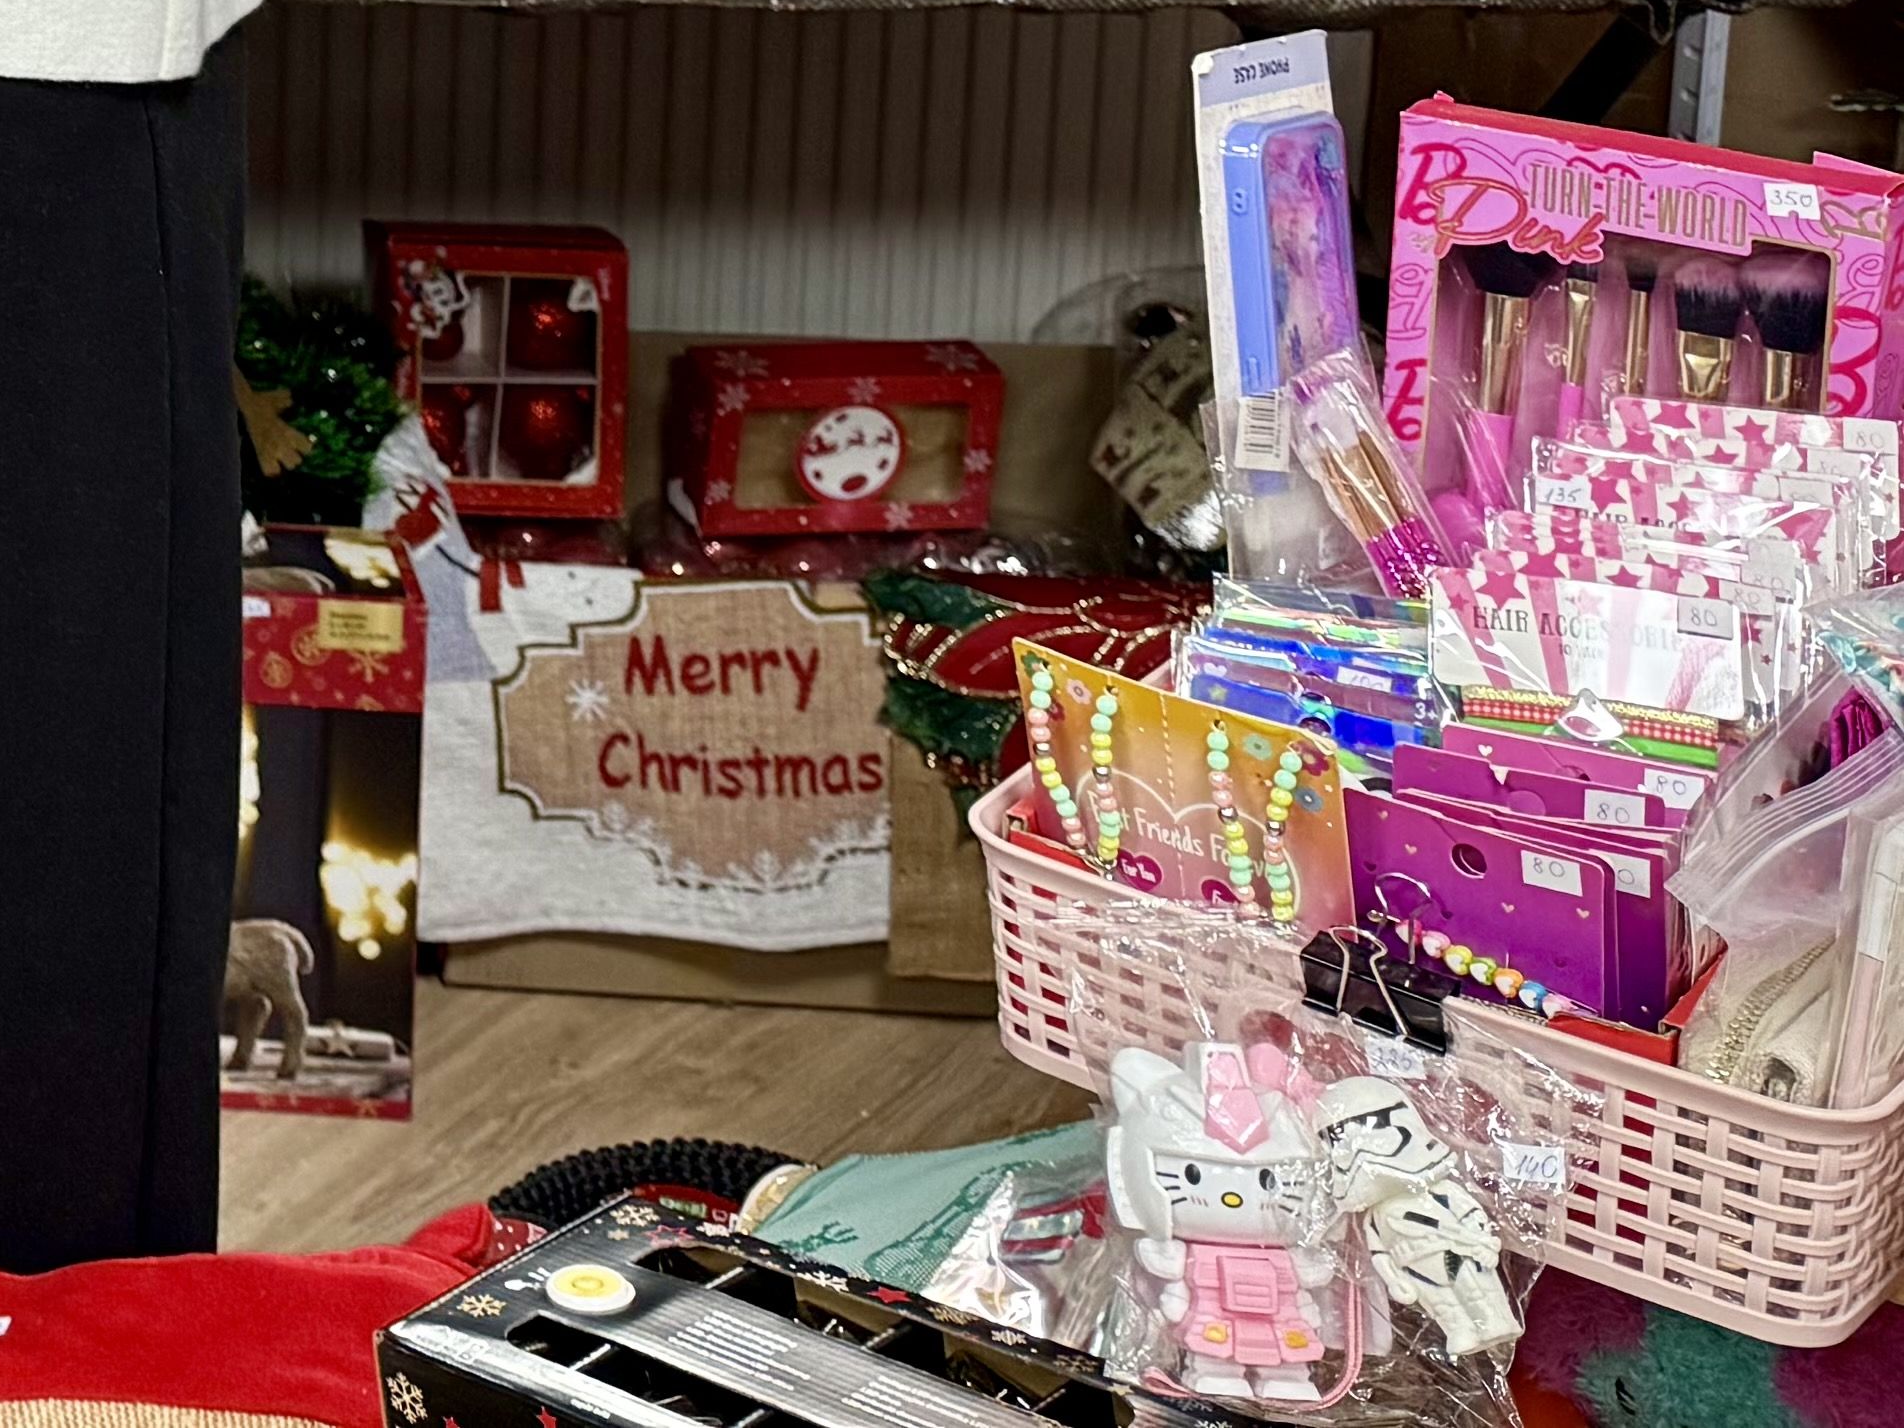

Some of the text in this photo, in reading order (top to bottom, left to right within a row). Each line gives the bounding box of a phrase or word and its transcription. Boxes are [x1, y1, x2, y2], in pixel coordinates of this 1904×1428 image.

[1529, 162, 1749, 250] TURN THE WORLD
[1768, 189, 1814, 209] 350
[1543, 486, 1580, 504] 135
[1472, 605, 1529, 634] HAIR
[1689, 605, 1718, 628] 80
[623, 633, 820, 713] Merry
[597, 728, 884, 800] Christmas
[1655, 775, 1688, 796] 80
[1596, 801, 1631, 824] 80
[1132, 806, 1205, 858] Friends
[1531, 856, 1567, 879] 80
[1515, 1152, 1561, 1180] 140
